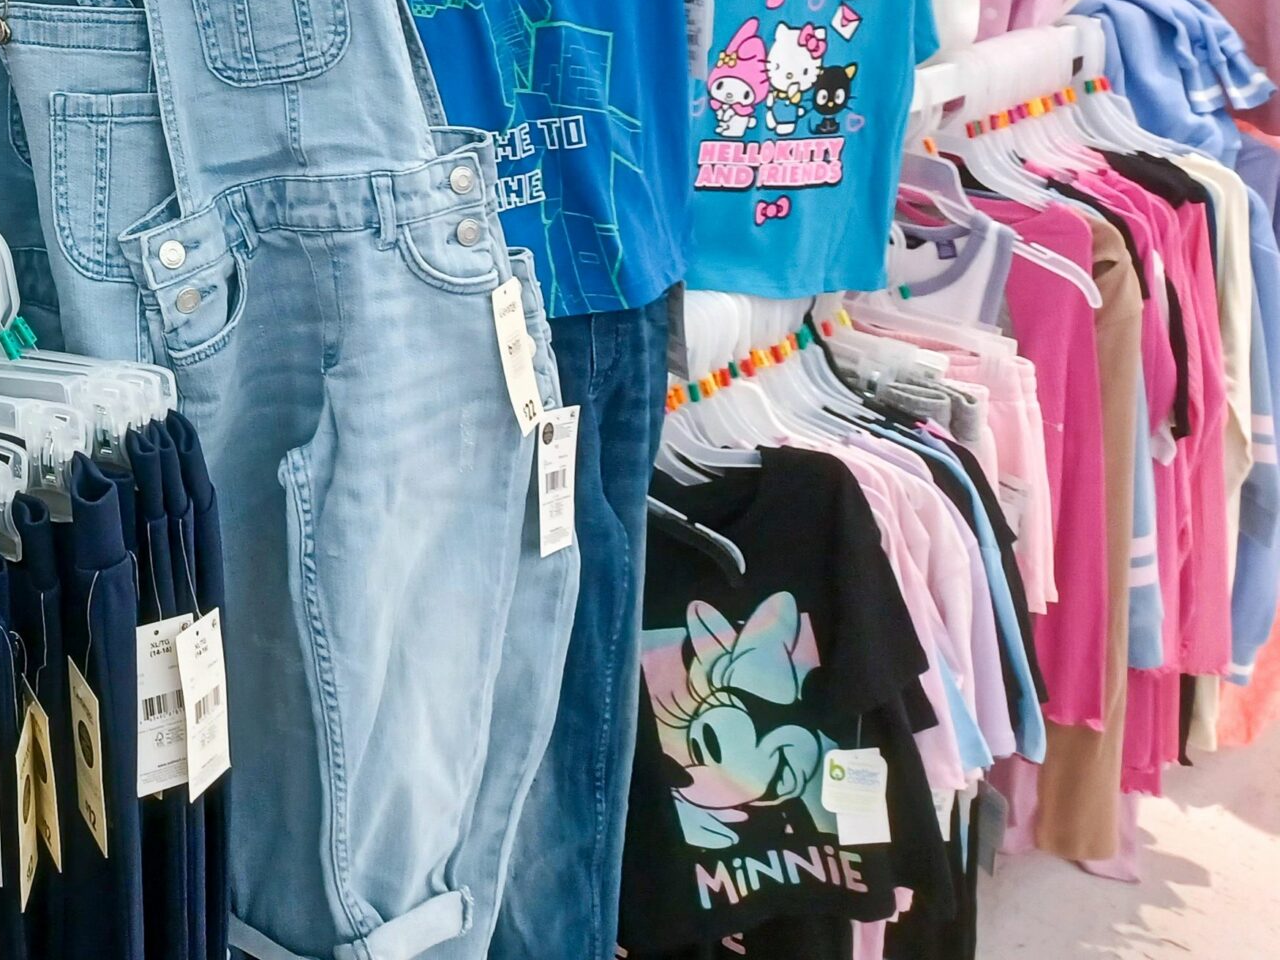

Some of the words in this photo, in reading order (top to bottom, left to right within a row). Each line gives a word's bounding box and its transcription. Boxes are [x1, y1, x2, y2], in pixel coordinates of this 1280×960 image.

[537, 115, 587, 150] TO
[698, 138, 775, 166] HELLO
[774, 137, 845, 163] KITTY
[694, 163, 754, 188] AND
[757, 160, 843, 187] FRIENDS
